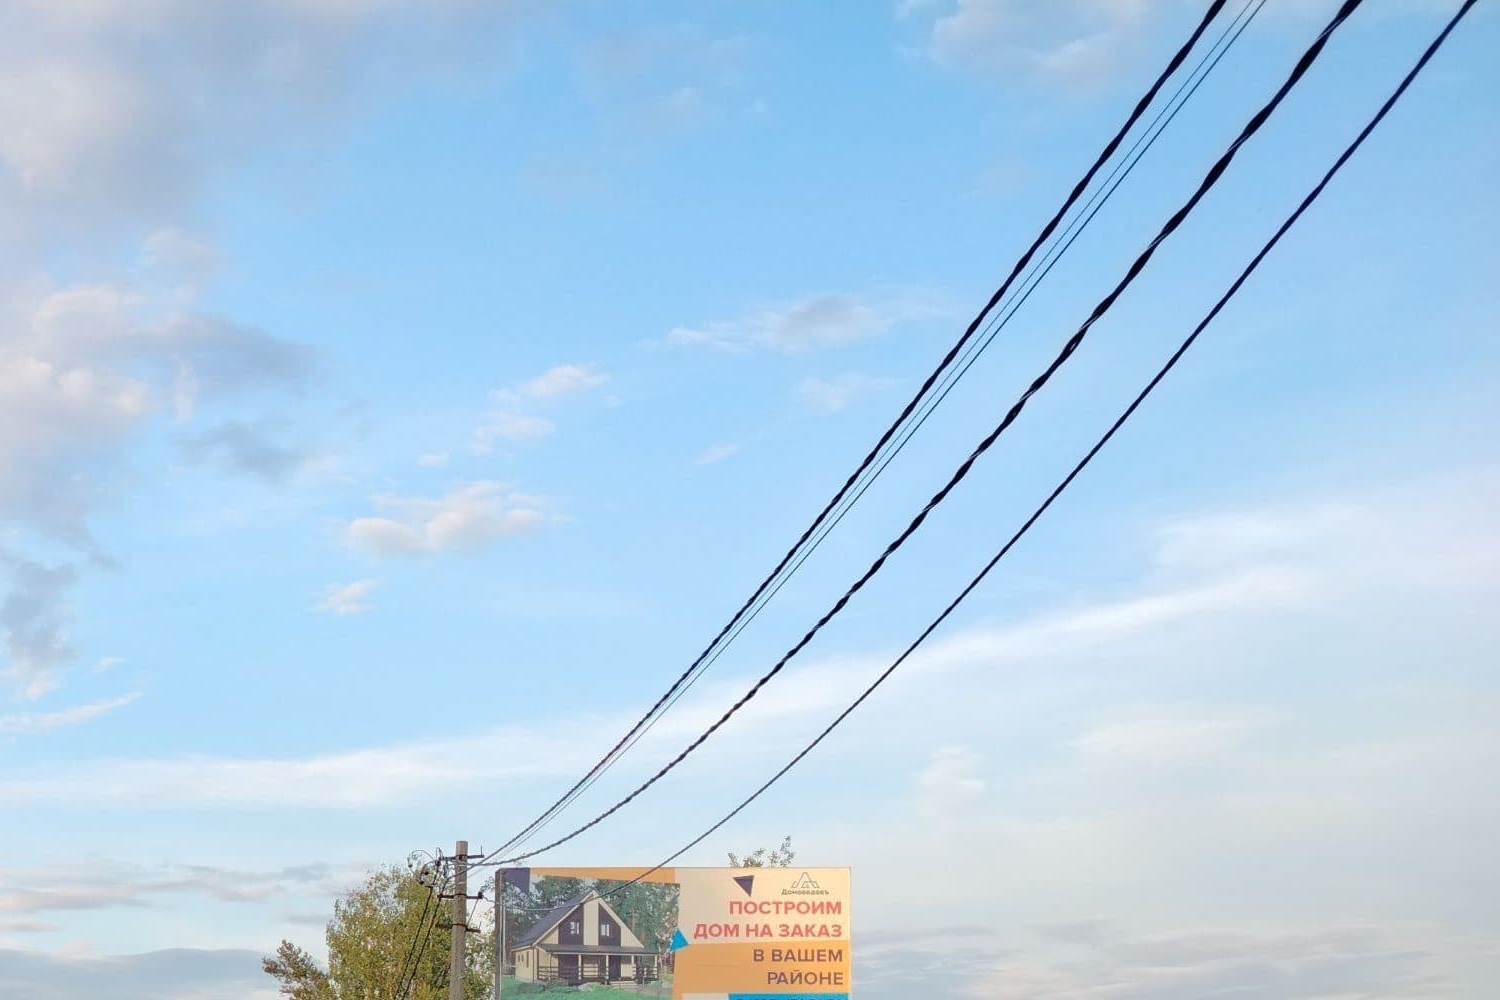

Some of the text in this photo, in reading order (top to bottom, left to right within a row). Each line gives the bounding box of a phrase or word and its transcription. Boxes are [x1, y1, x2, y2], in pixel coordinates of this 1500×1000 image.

[729, 901, 842, 915] ПОСТРОИМ
[693, 923, 842, 939] ДОМ НА ЗАКАЗ
[753, 949, 843, 962] В ВАШЕМ
[767, 969, 844, 985] РАЙОНЕ
